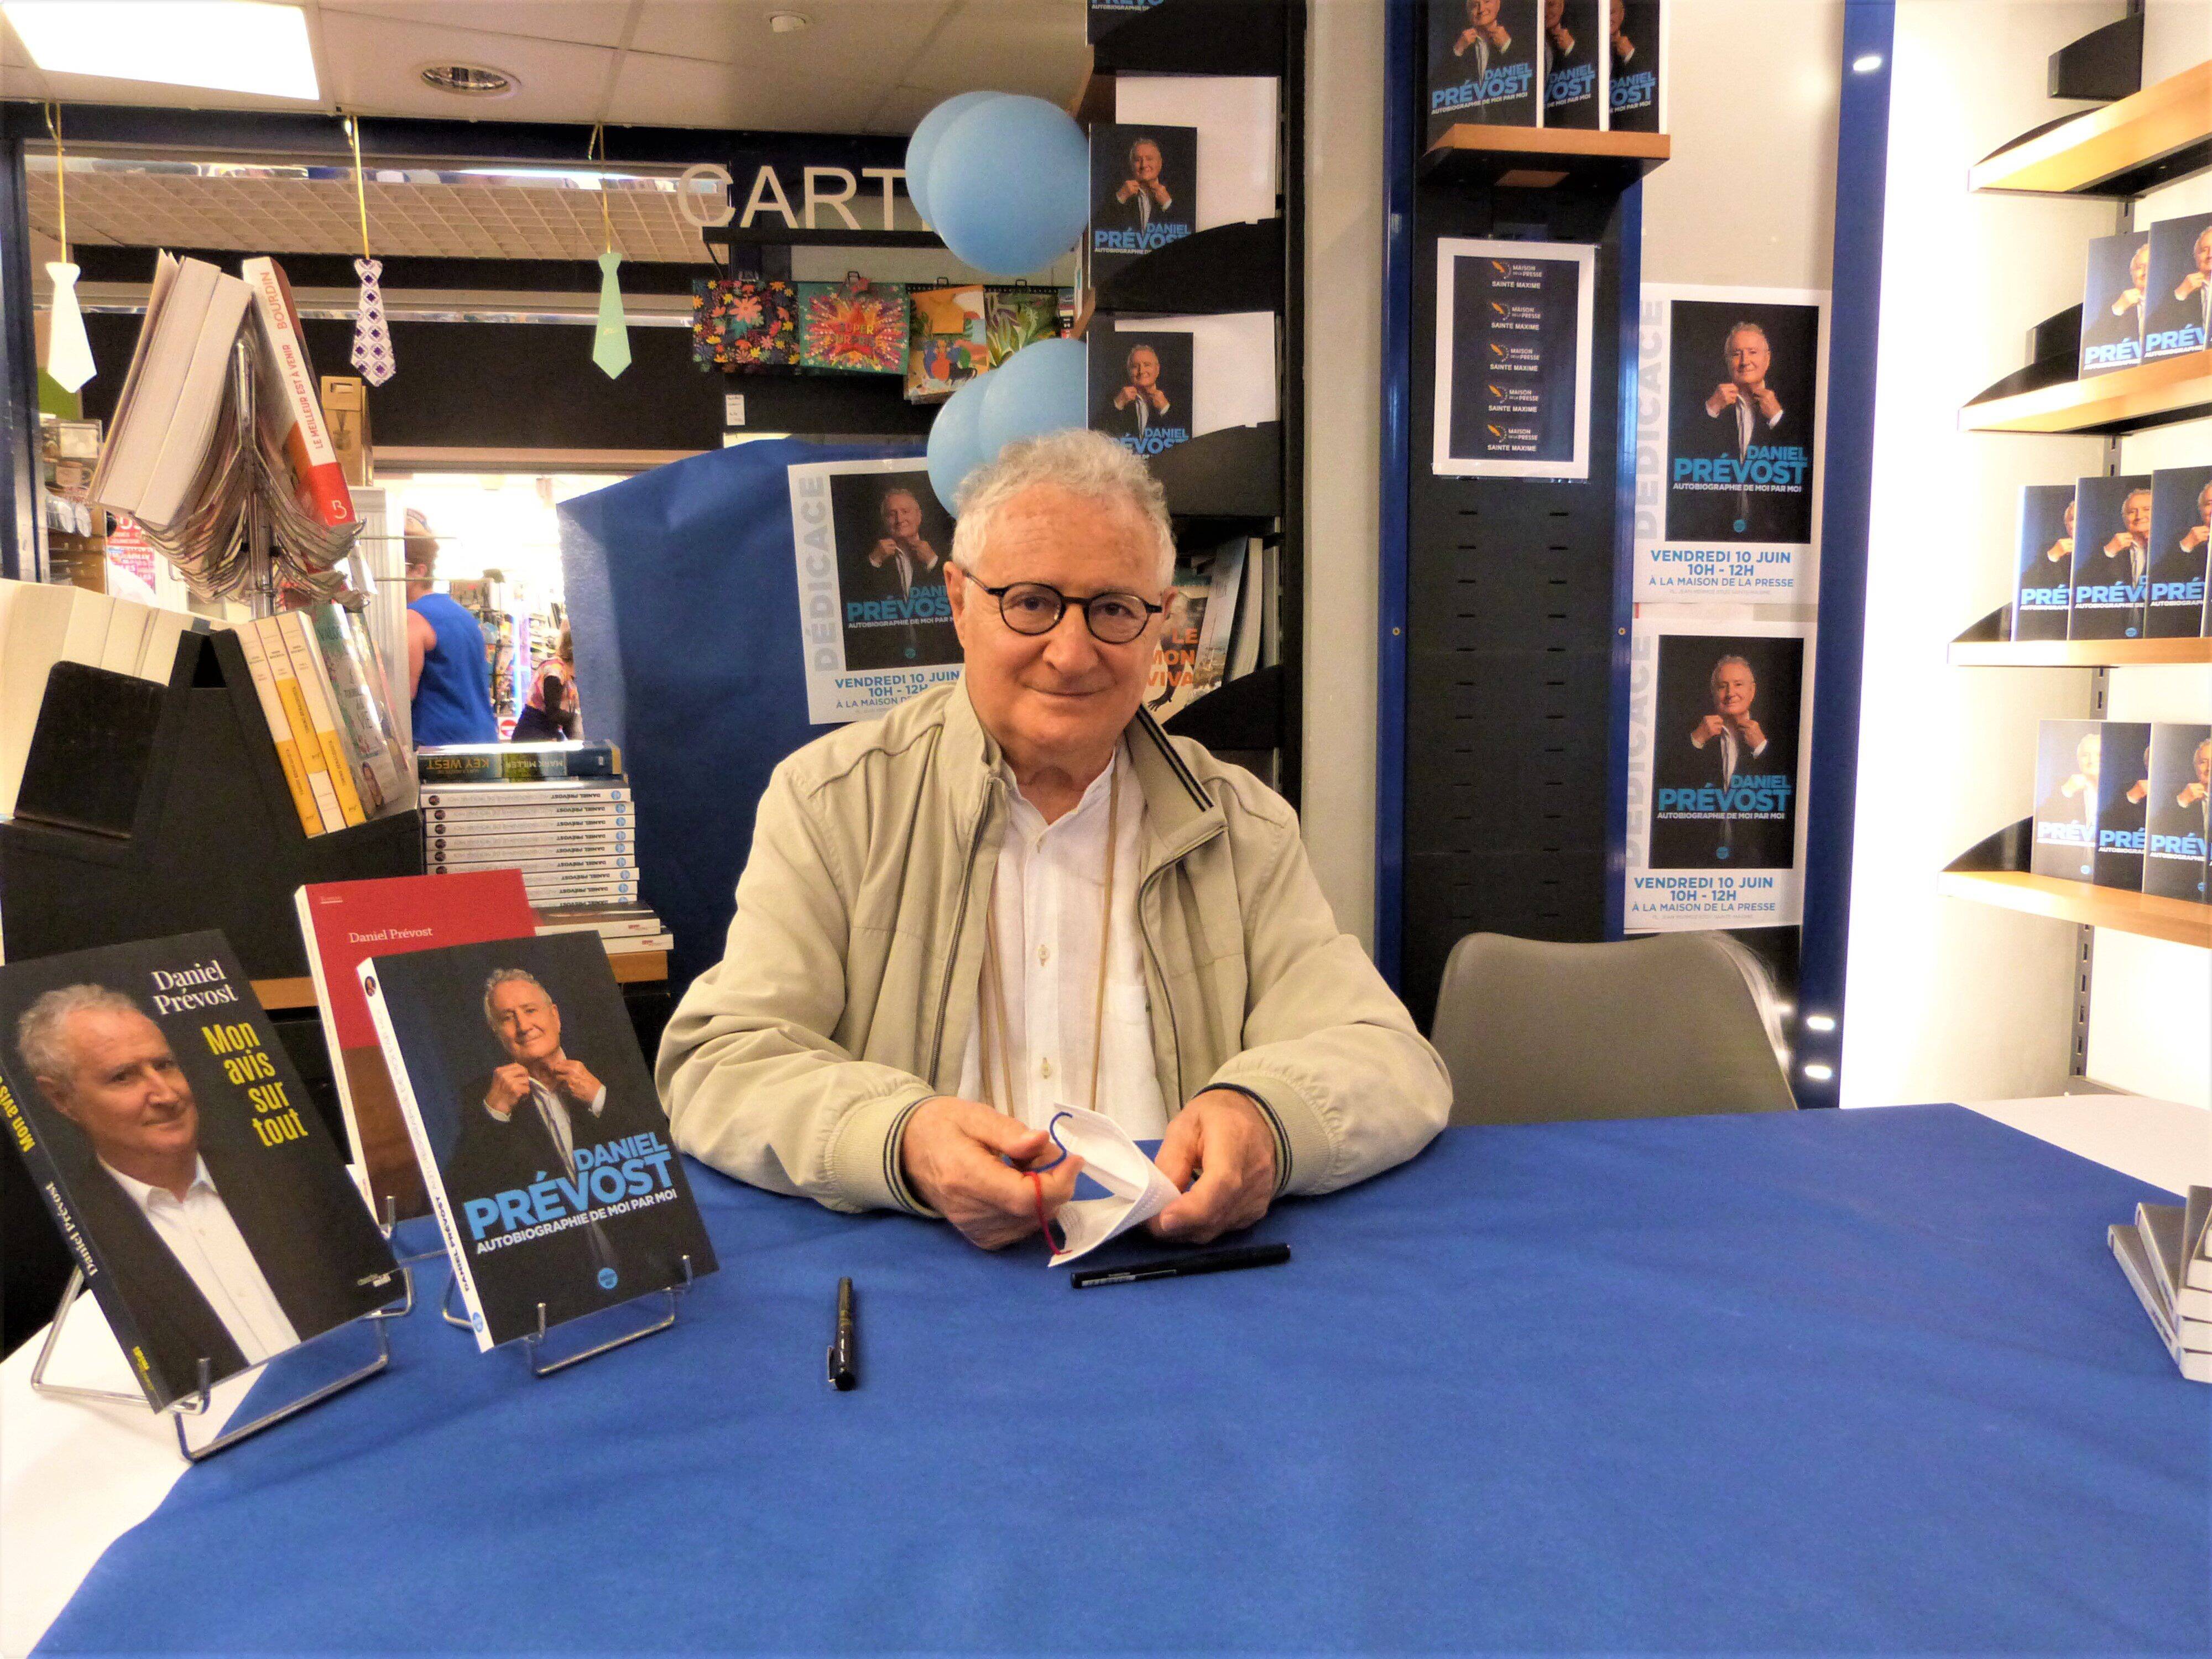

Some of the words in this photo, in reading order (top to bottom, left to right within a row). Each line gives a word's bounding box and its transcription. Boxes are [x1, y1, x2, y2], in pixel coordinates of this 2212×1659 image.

[1485, 62, 1532, 81] DANIEL
[1432, 73, 1532, 109] PRÉVOST
[1431, 100, 1481, 115] AUTOBIOGRAPHIE
[677, 164, 932, 231] CART
[1146, 222, 1192, 234] DANIEL
[260, 271, 288, 330] BOURDIN
[282, 343, 297, 371] VENIR
[293, 379, 306, 394] EST
[299, 396, 319, 437] MEILLEUR
[314, 437, 323, 449] LE
[1144, 427, 1189, 439] DANIEL
[1747, 445, 1808, 461] DANIEL
[1674, 453, 1807, 484] PRÉVOST
[1673, 483, 1743, 491] AUTOBIOGRAPHIE
[1651, 550, 1730, 562] VENDREDI
[1736, 551, 1751, 563] 10
[1756, 552, 1791, 564] JUIN
[799, 476, 839, 671] DÉDICACE
[1649, 575, 1656, 585] À
[1660, 577, 1673, 586] LA
[1677, 577, 1718, 586] MAISON
[1722, 578, 1735, 586] DE
[1755, 578, 1794, 587] PRESSE
[1688, 564, 1714, 575] 10H
[1729, 564, 1754, 576] 12H
[2021, 583, 2070, 605] PRÉ
[2151, 577, 2205, 601] PRÉ
[848, 619, 909, 628] AUTOBIOGRAPHIE
[1172, 628, 1198, 644] LE
[834, 675, 906, 688] VENDREDI
[910, 674, 924, 683] 10
[929, 671, 960, 682] JUIN
[861, 697, 898, 706] MAISON
[869, 686, 893, 697] 10H
[426, 759, 462, 769] WEST
[466, 758, 489, 769] KEY
[1730, 775, 1792, 788] DANIEL
[1658, 782, 1792, 812] PRÉVOST
[1634, 877, 1713, 889] VENDREDI
[1718, 877, 1734, 888] 10
[1739, 877, 1773, 888] JUIN
[1632, 901, 1639, 911] À
[1660, 903, 1701, 911] MAISON
[1670, 890, 1697, 901] 10H
[1712, 890, 1736, 901] 12H
[348, 930, 388, 943] Daniel
[389, 927, 433, 940] Prévost
[151, 959, 227, 990] Daniel
[153, 983, 239, 1015] Prévost
[201, 1022, 261, 1055] Mon
[223, 1050, 276, 1085] avis
[248, 1081, 290, 1113] sur
[13, 1116, 35, 1152] Mon
[252, 1108, 309, 1147] tout
[573, 1131, 669, 1172] DANIEL
[45, 1181, 75, 1232] Prévost
[463, 1151, 674, 1240] PRÉVOST
[435, 1196, 455, 1248] PRÉVOST
[476, 1211, 589, 1255] AUTOBIOGRAPHIE
[589, 1208, 607, 1221] DE
[607, 1203, 631, 1215] MOI
[632, 1197, 655, 1211] PAR
[655, 1188, 678, 1204] MOI
[70, 1232, 98, 1276] Daniel
[455, 1248, 469, 1292] DANIEL
